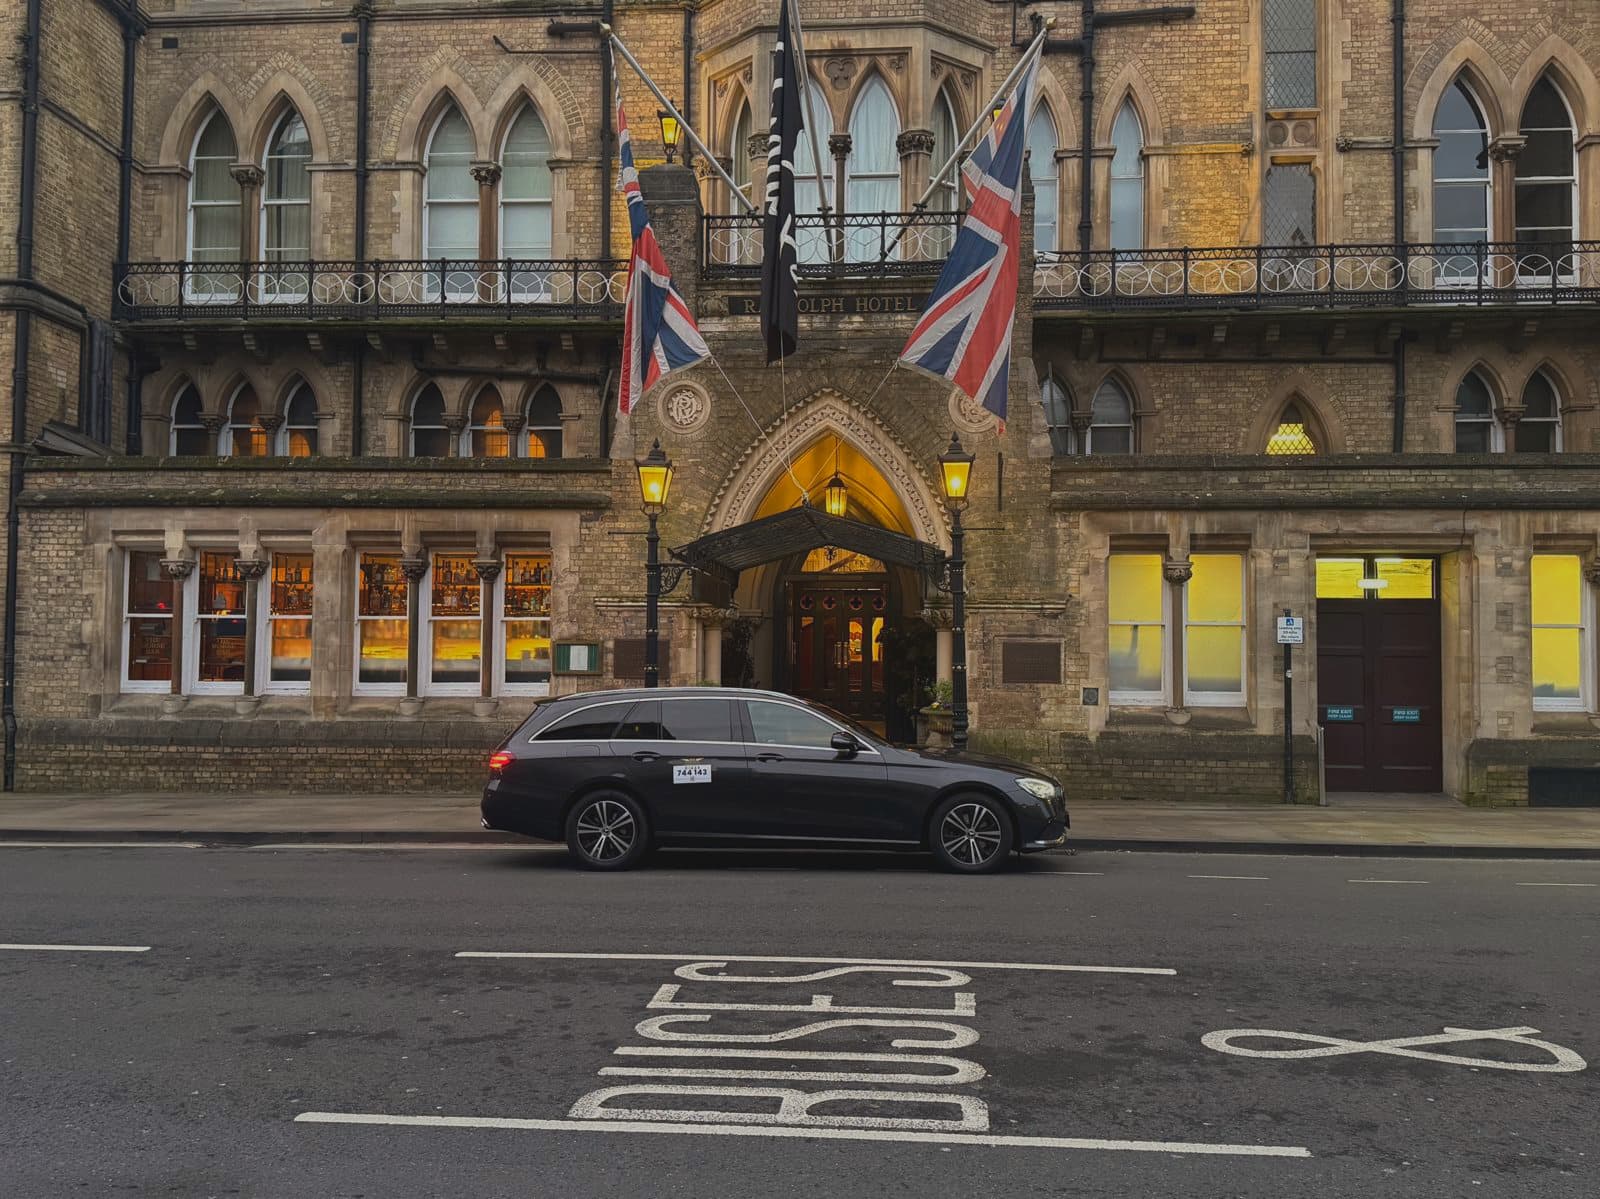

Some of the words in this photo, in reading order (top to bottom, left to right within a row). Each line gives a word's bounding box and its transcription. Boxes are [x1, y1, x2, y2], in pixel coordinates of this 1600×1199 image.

[744, 297, 844, 313] ROLPH
[855, 296, 917, 312] HOTEL
[567, 962, 990, 1132] BUSES
